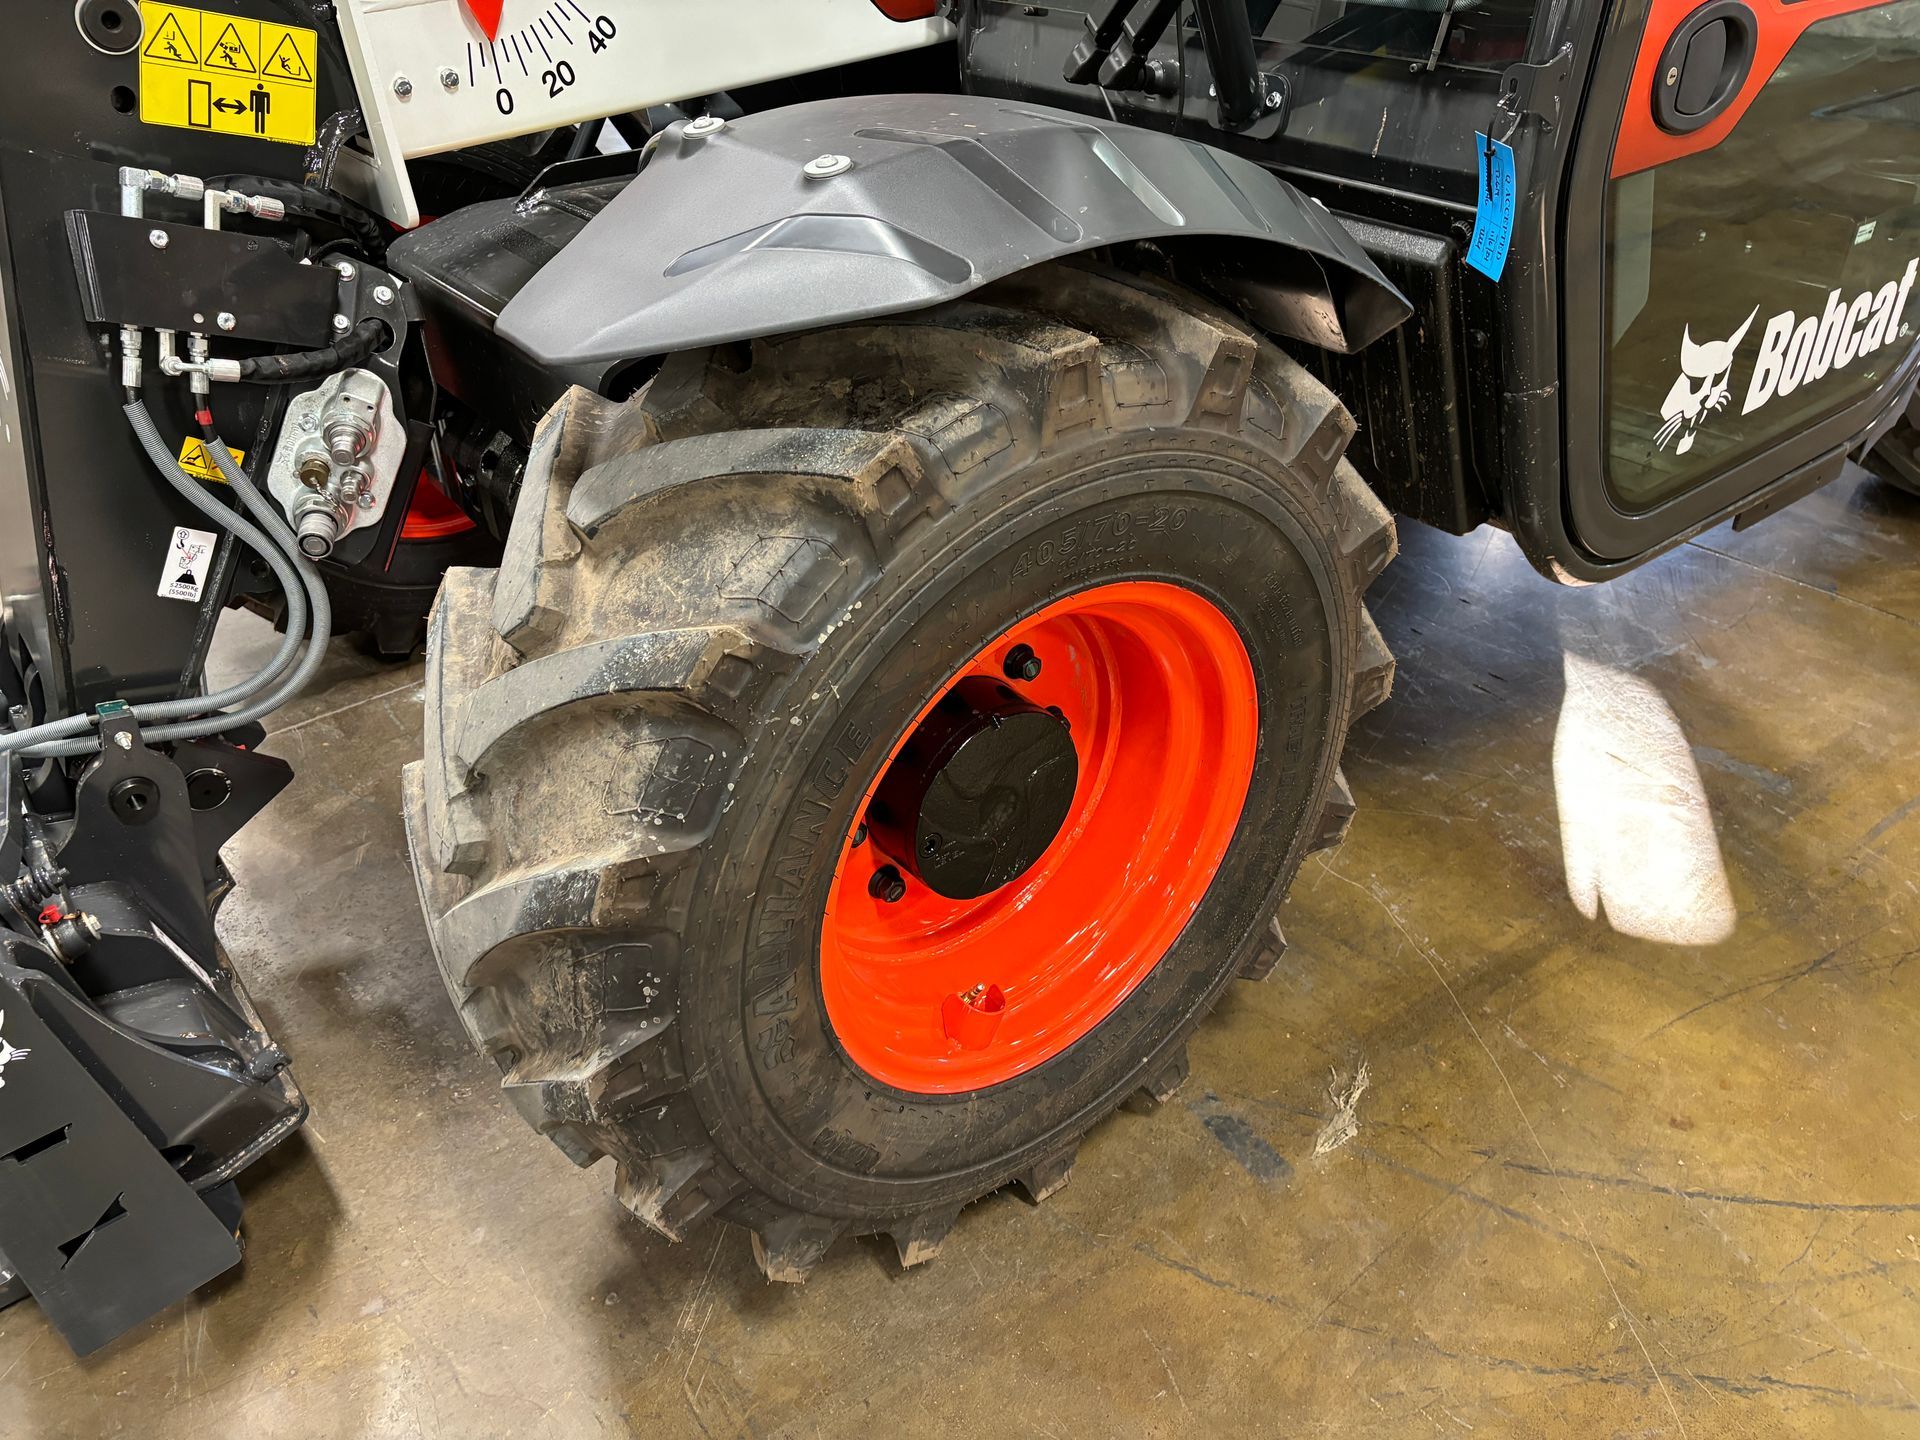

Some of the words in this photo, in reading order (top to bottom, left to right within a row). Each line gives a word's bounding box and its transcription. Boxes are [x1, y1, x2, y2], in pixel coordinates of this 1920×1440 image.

[588, 15, 617, 54] 40
[496, 88, 514, 115] 0
[541, 60, 576, 99] 20
[1741, 257, 1920, 416] Bobcat
[1012, 507, 1189, 578] 405/70-20
[752, 720, 872, 1017] ALLIANCE
